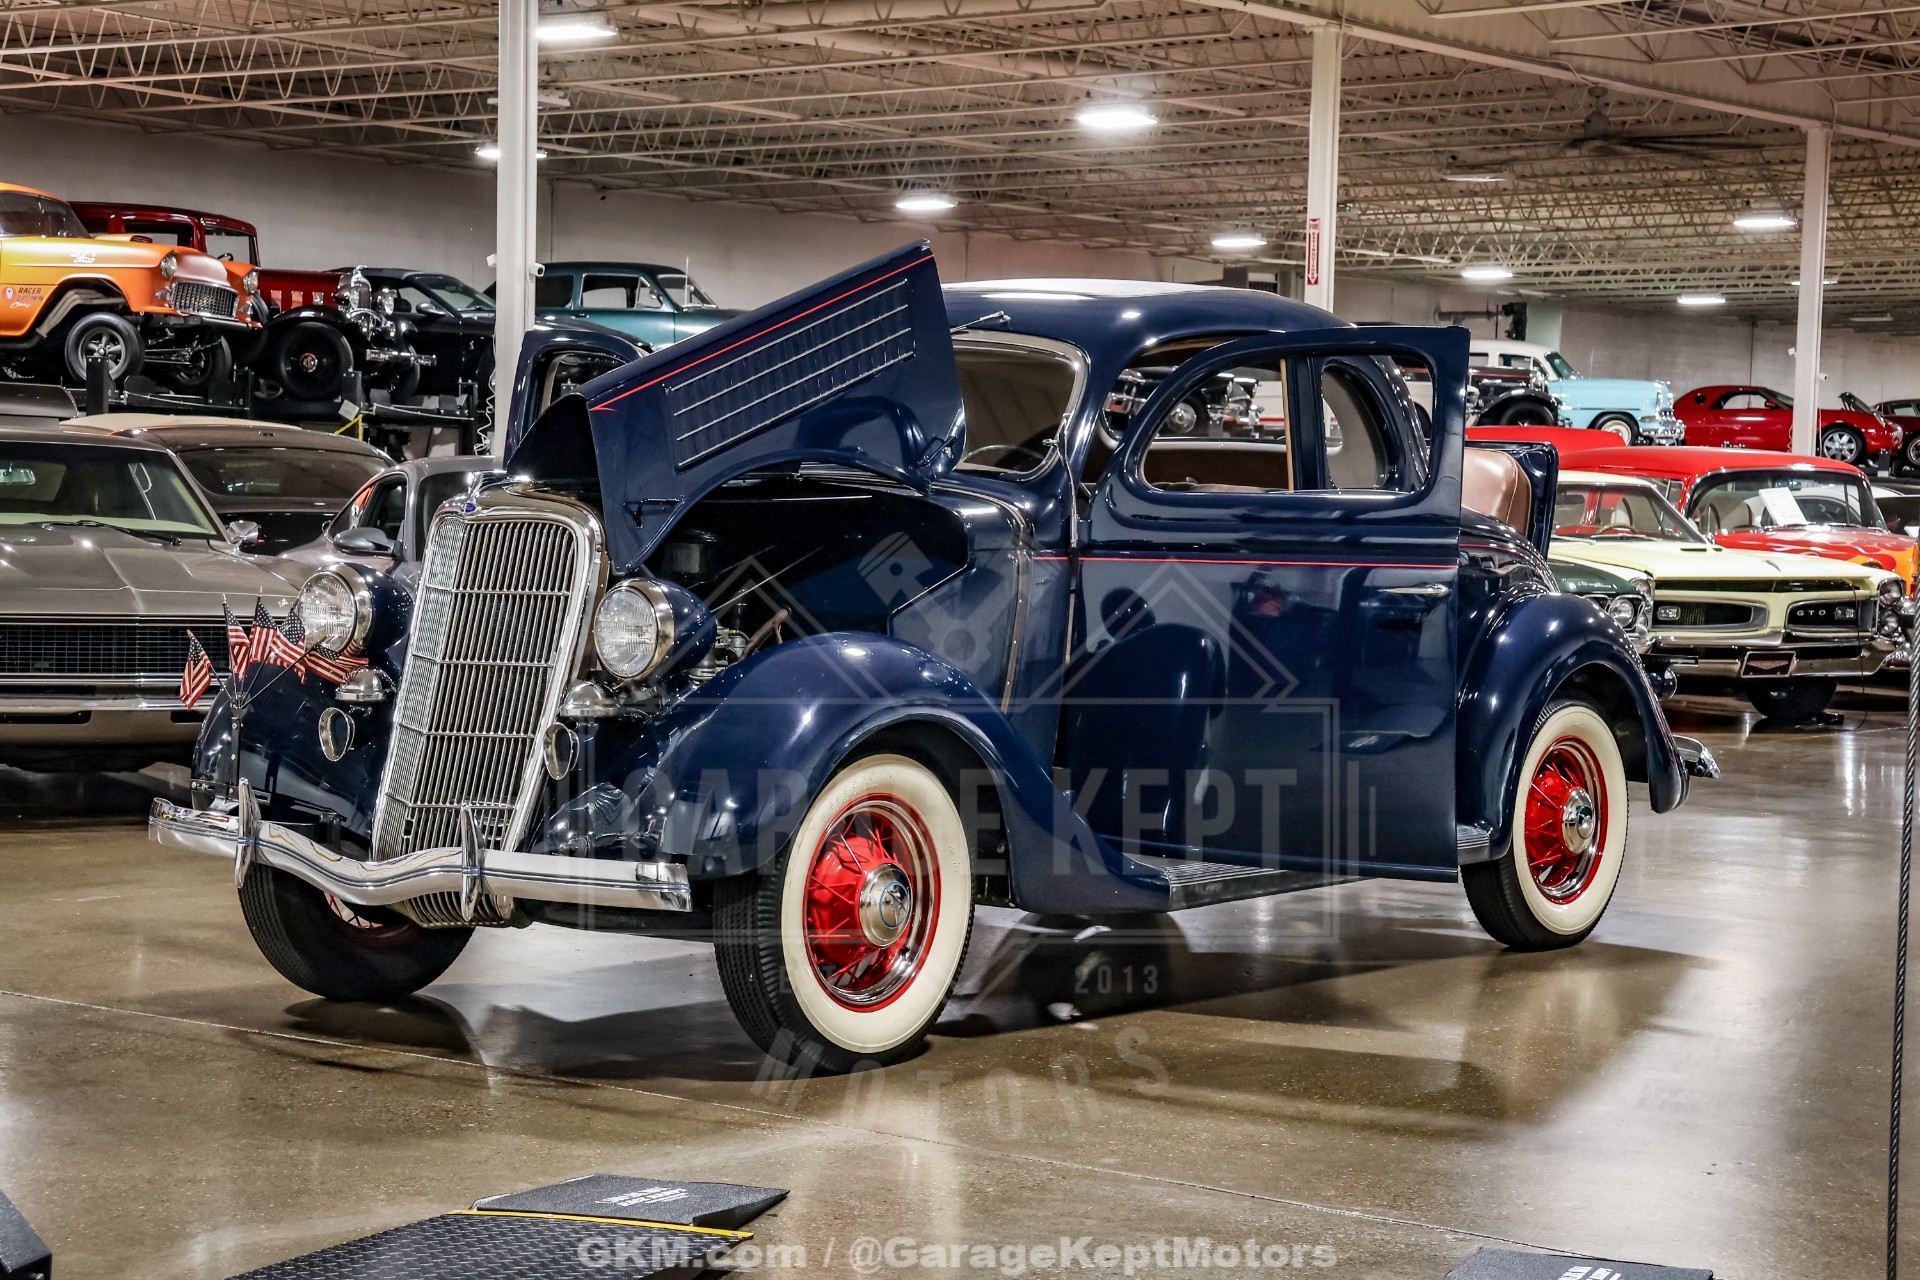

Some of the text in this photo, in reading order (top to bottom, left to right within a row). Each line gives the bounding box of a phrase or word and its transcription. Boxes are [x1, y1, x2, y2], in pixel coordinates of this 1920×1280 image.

[18, 287, 42, 295] RACER
[17, 294, 44, 302] BROWN
[1796, 609, 1826, 617] GTO
